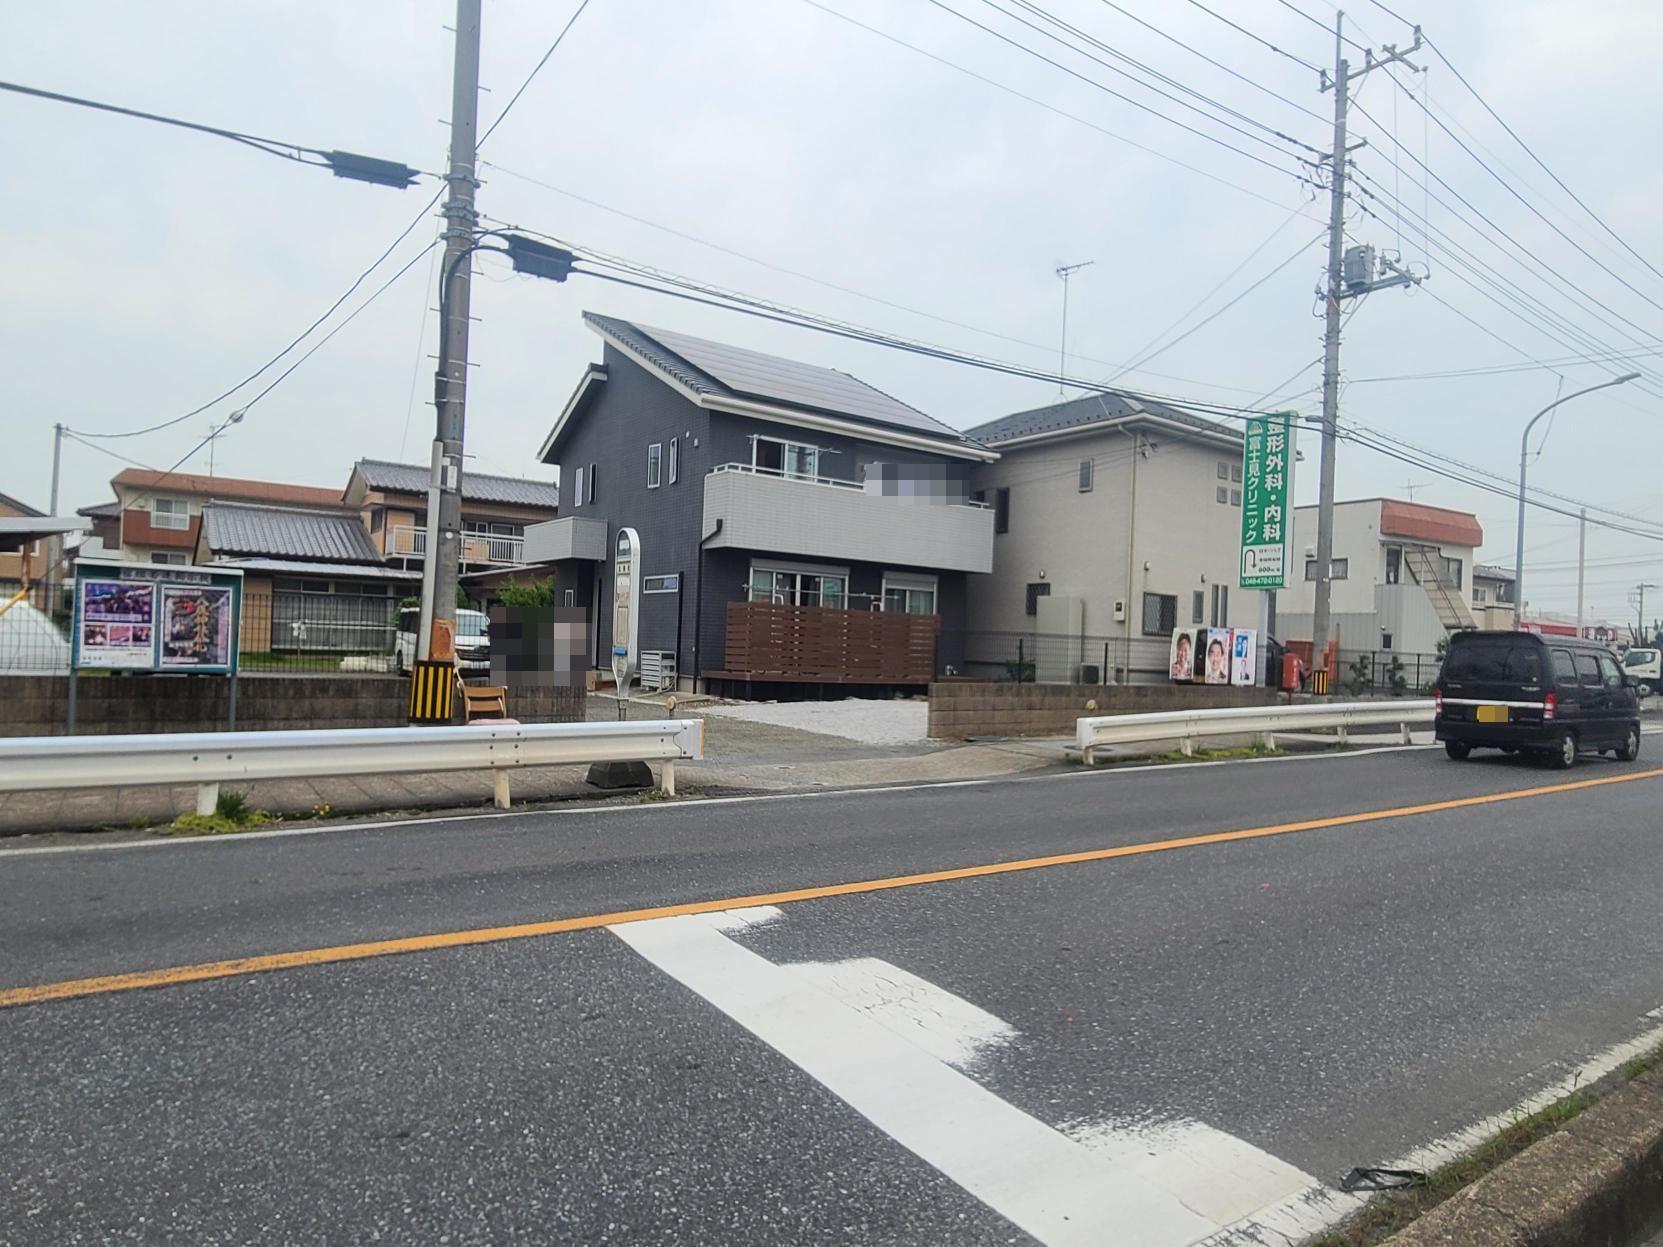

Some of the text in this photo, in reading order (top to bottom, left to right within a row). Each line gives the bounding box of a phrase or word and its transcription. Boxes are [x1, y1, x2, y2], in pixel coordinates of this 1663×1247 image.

[1246, 436, 1262, 543] 富士見クリニック
